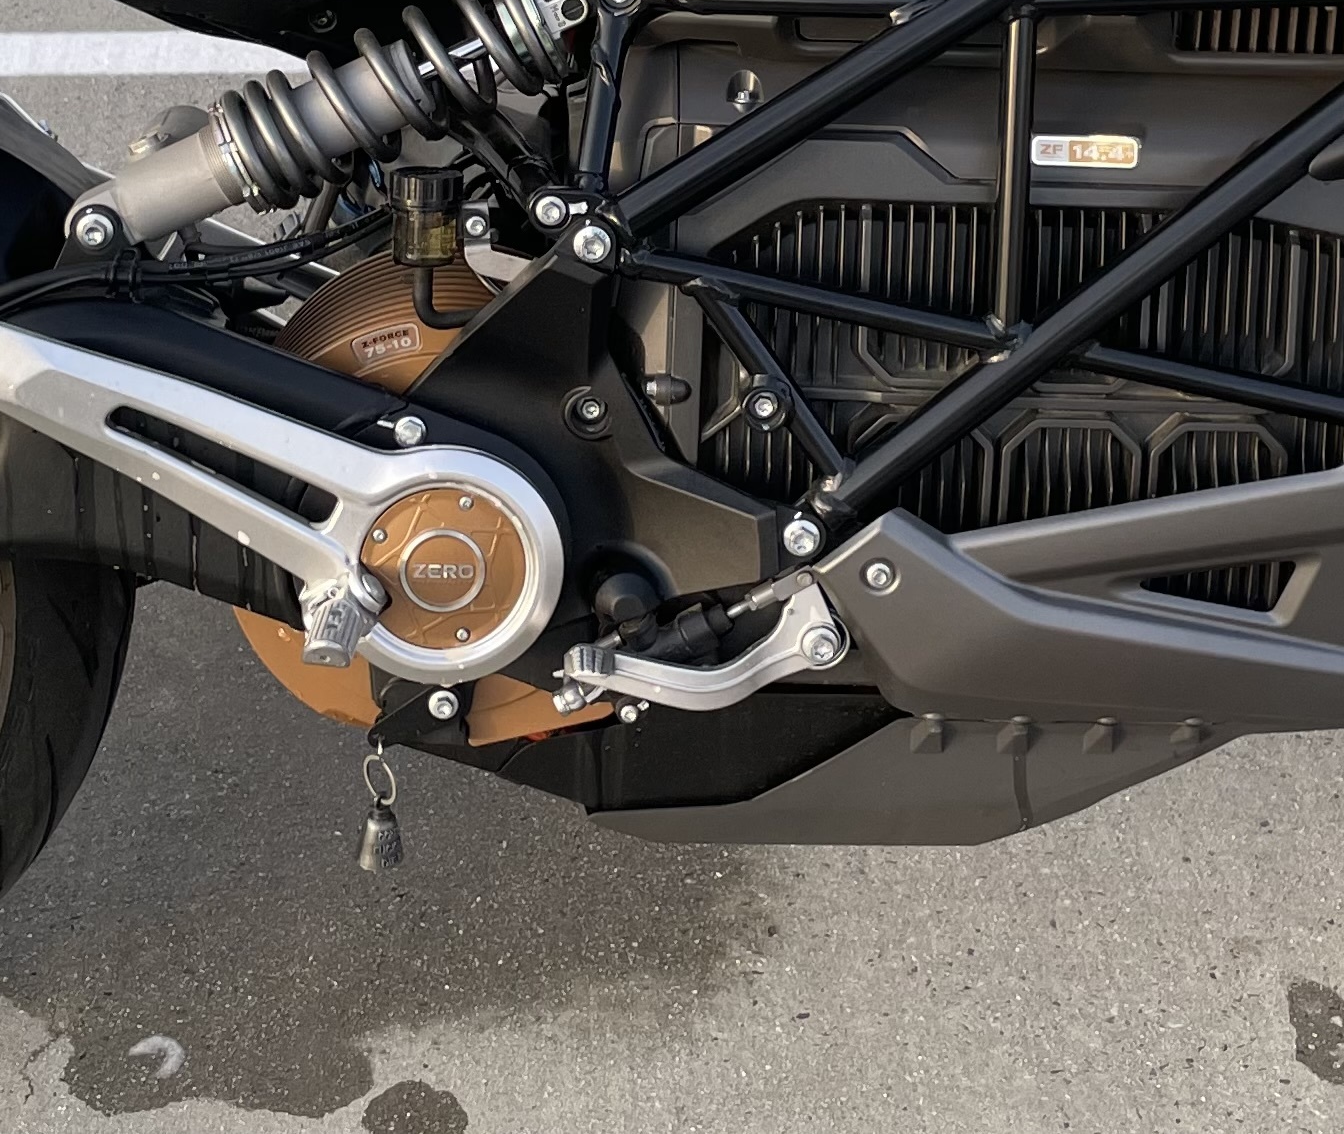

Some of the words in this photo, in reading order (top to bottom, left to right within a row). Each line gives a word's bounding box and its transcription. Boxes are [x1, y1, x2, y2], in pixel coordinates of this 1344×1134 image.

[1040, 143, 1063, 155] ZF
[361, 329, 410, 348] Z-FORCE
[364, 337, 412, 358] 75-10
[413, 563, 474, 579] ZERO
